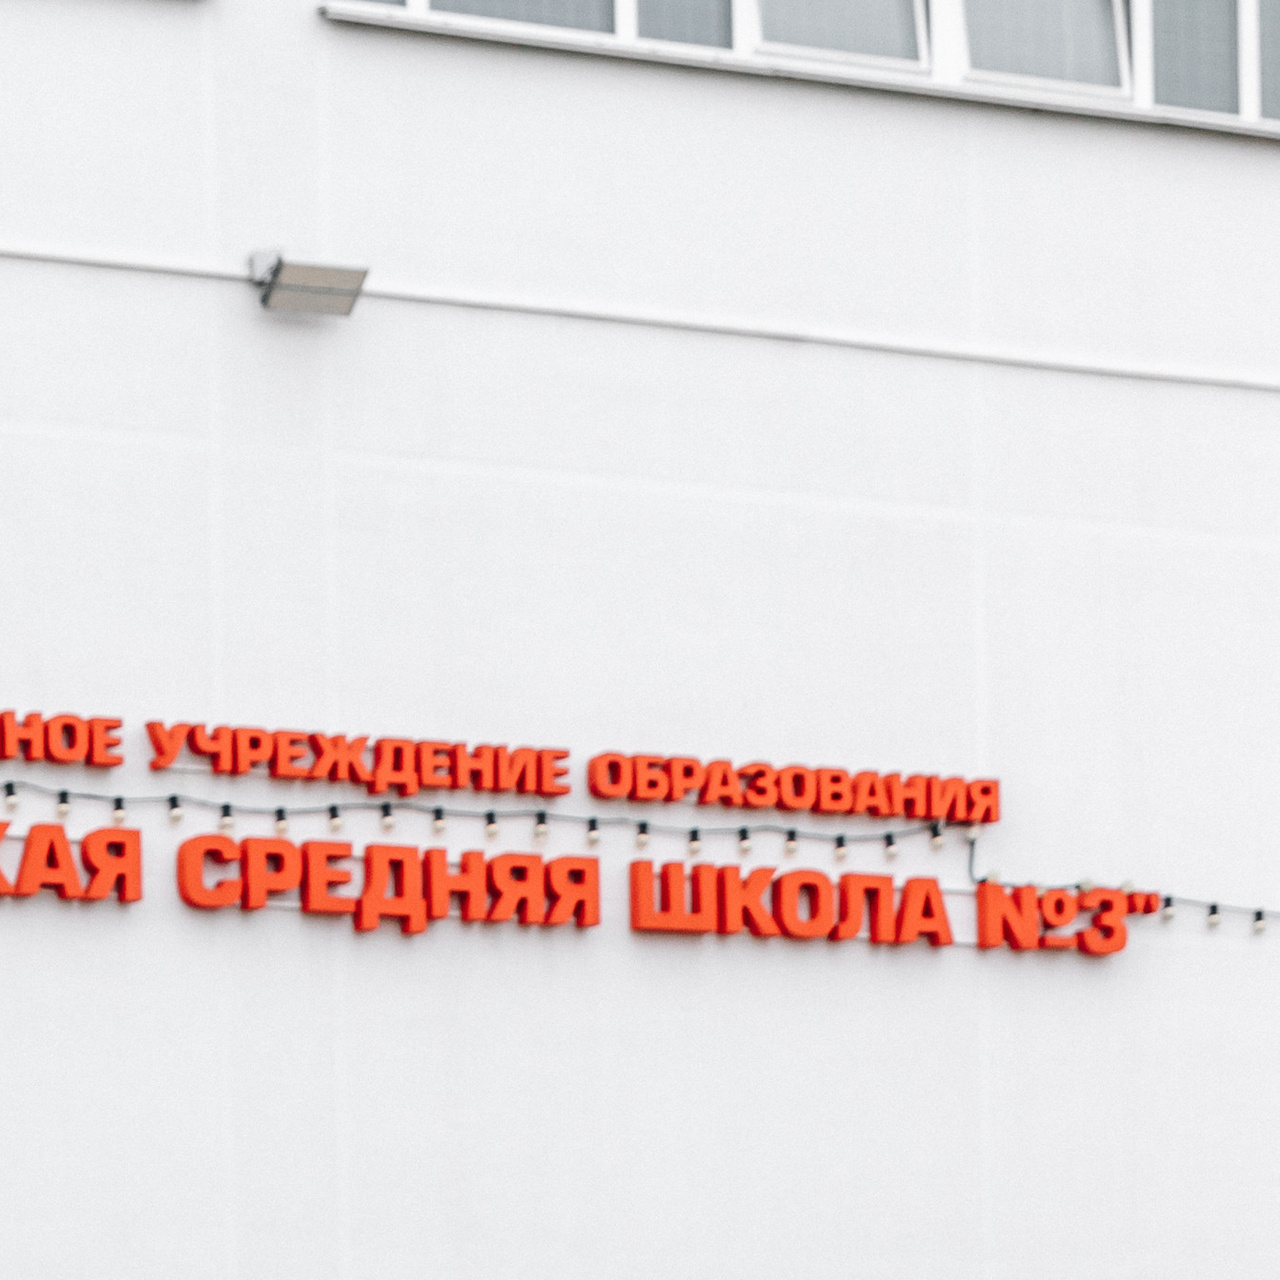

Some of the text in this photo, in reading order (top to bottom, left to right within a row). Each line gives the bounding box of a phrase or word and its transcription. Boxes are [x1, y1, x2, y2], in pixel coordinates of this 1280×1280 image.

[146, 722, 570, 798] УЧРЕЖДЕНИЕ
[587, 753, 1000, 824] ОБРАЗОВАНИЯ
[176, 834, 600, 935] СРЕДНЯЯ
[629, 860, 954, 947] ШКОЛА
